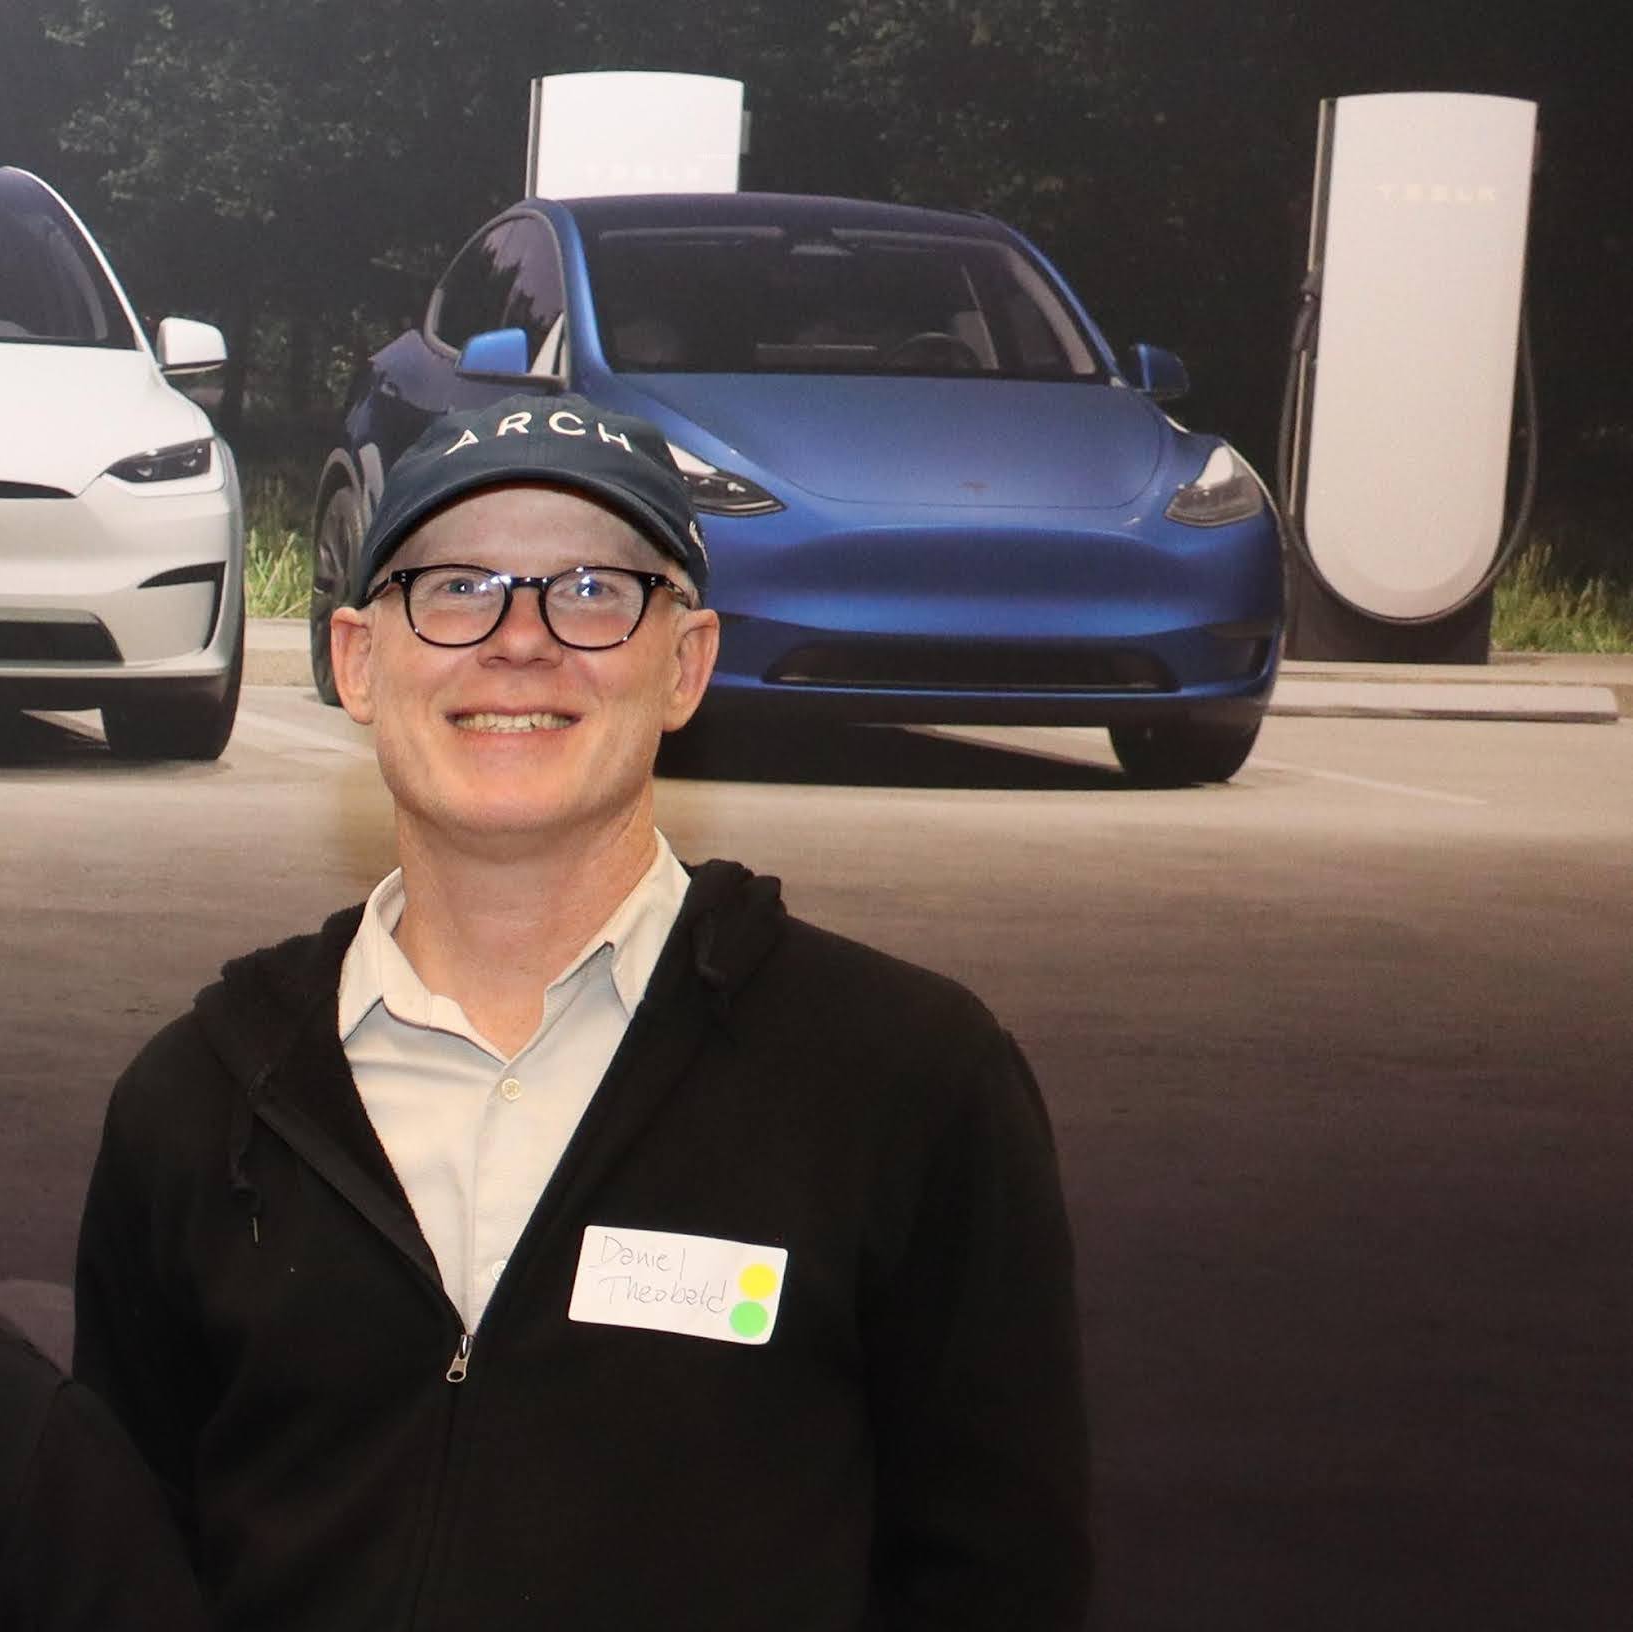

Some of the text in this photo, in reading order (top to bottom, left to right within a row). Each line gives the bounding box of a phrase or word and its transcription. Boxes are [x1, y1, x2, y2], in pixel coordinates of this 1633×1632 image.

[443, 411, 633, 456] ARCH
[601, 1235, 686, 1280] Daniel
[598, 1276, 728, 1313] Theobald
